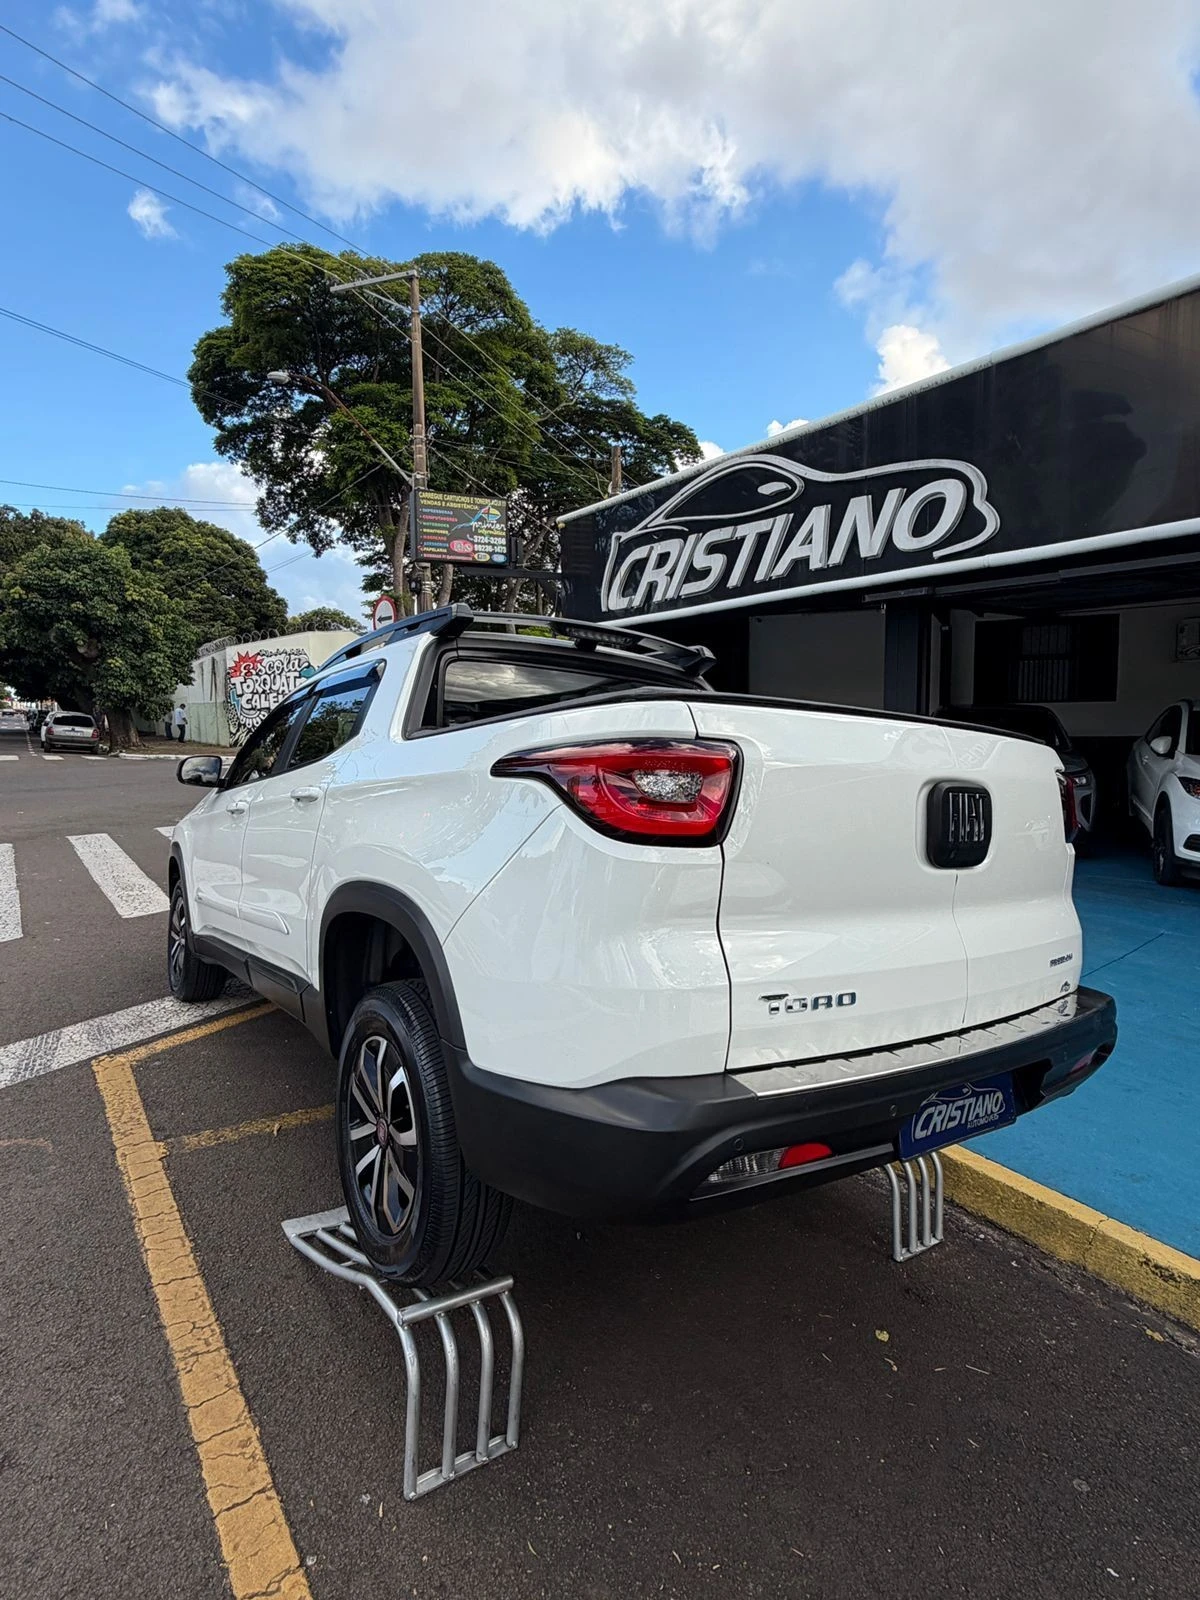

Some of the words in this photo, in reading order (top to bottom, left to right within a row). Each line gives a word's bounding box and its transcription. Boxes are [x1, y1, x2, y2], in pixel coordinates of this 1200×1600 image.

[608, 478, 967, 610] CRISTIANO
[948, 792, 987, 842] FIAT
[759, 992, 857, 1015] TORO
[914, 1091, 1003, 1140] CRISTIANO
